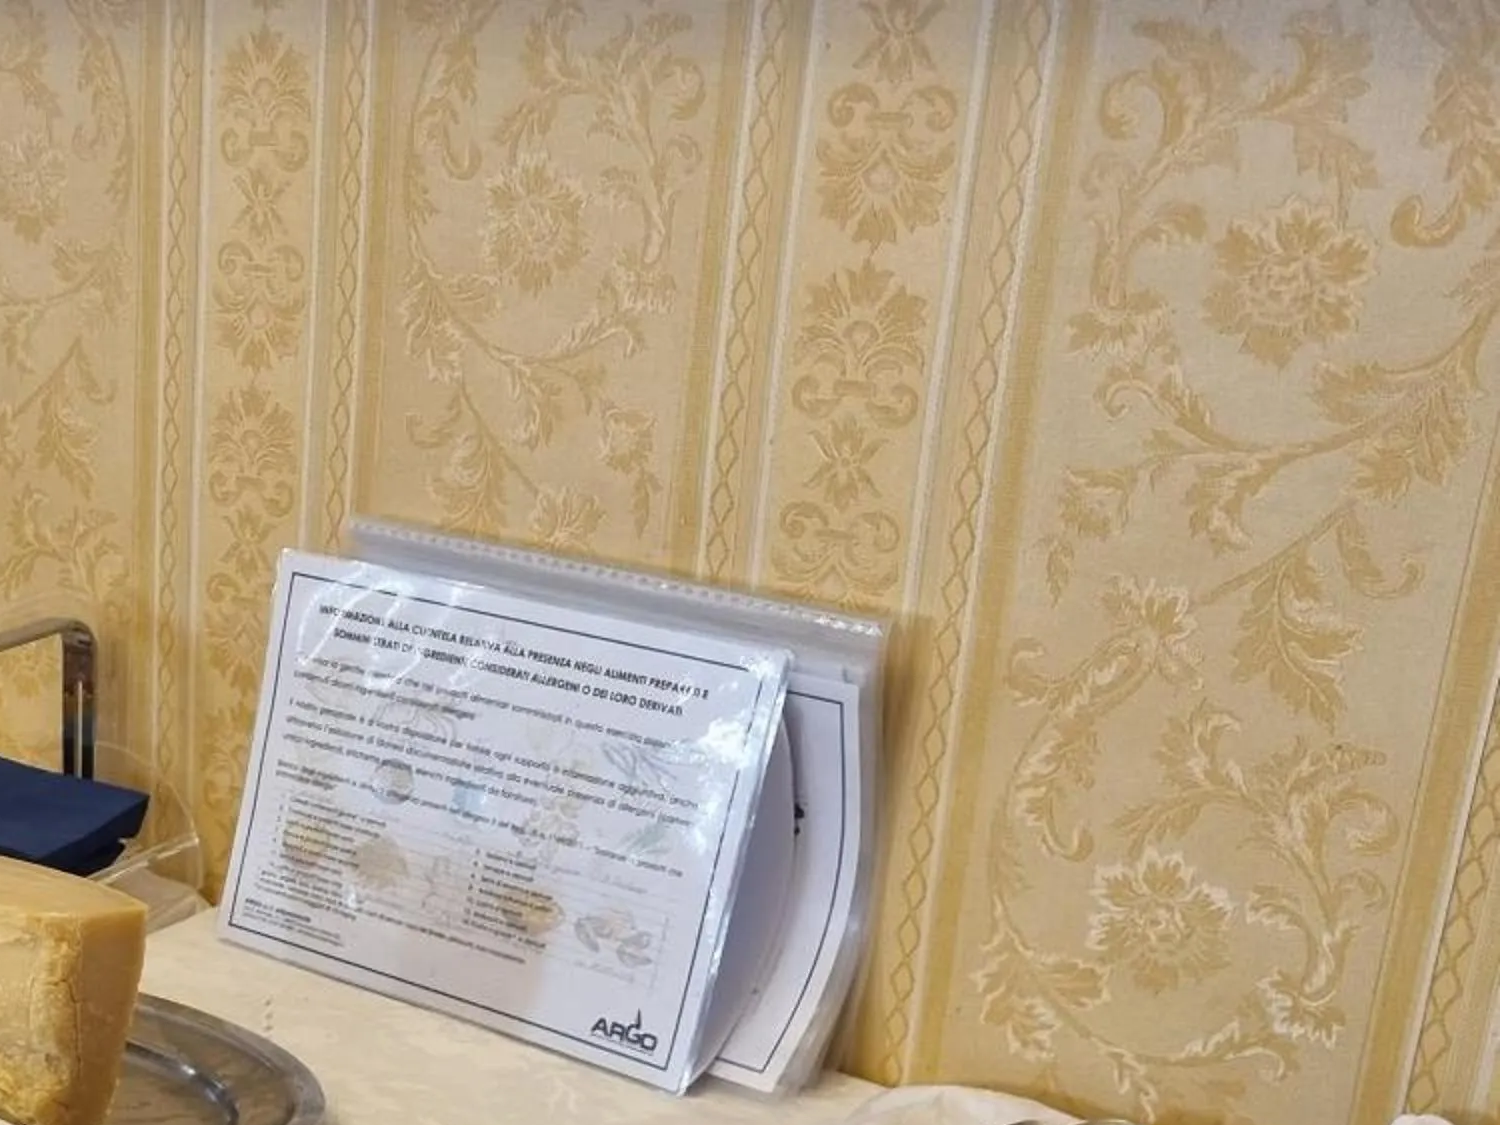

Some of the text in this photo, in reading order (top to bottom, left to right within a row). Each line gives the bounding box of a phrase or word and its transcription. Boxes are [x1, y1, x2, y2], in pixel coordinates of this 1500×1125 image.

[387, 618, 410, 632] ALLA
[411, 624, 457, 643] CLINTELA
[503, 644, 525, 658] ALLA
[527, 649, 572, 668] PRESENZA
[573, 660, 602, 675] NEGLI
[603, 667, 647, 685] ALIMENTI
[470, 657, 530, 680] CONSIDERATI
[531, 673, 581, 693] ALLERGENI
[581, 684, 591, 695] O
[592, 687, 609, 699] DEI
[609, 691, 637, 706] LORO
[638, 697, 683, 716] DERIVATI
[591, 1008, 658, 1051] ARGO
